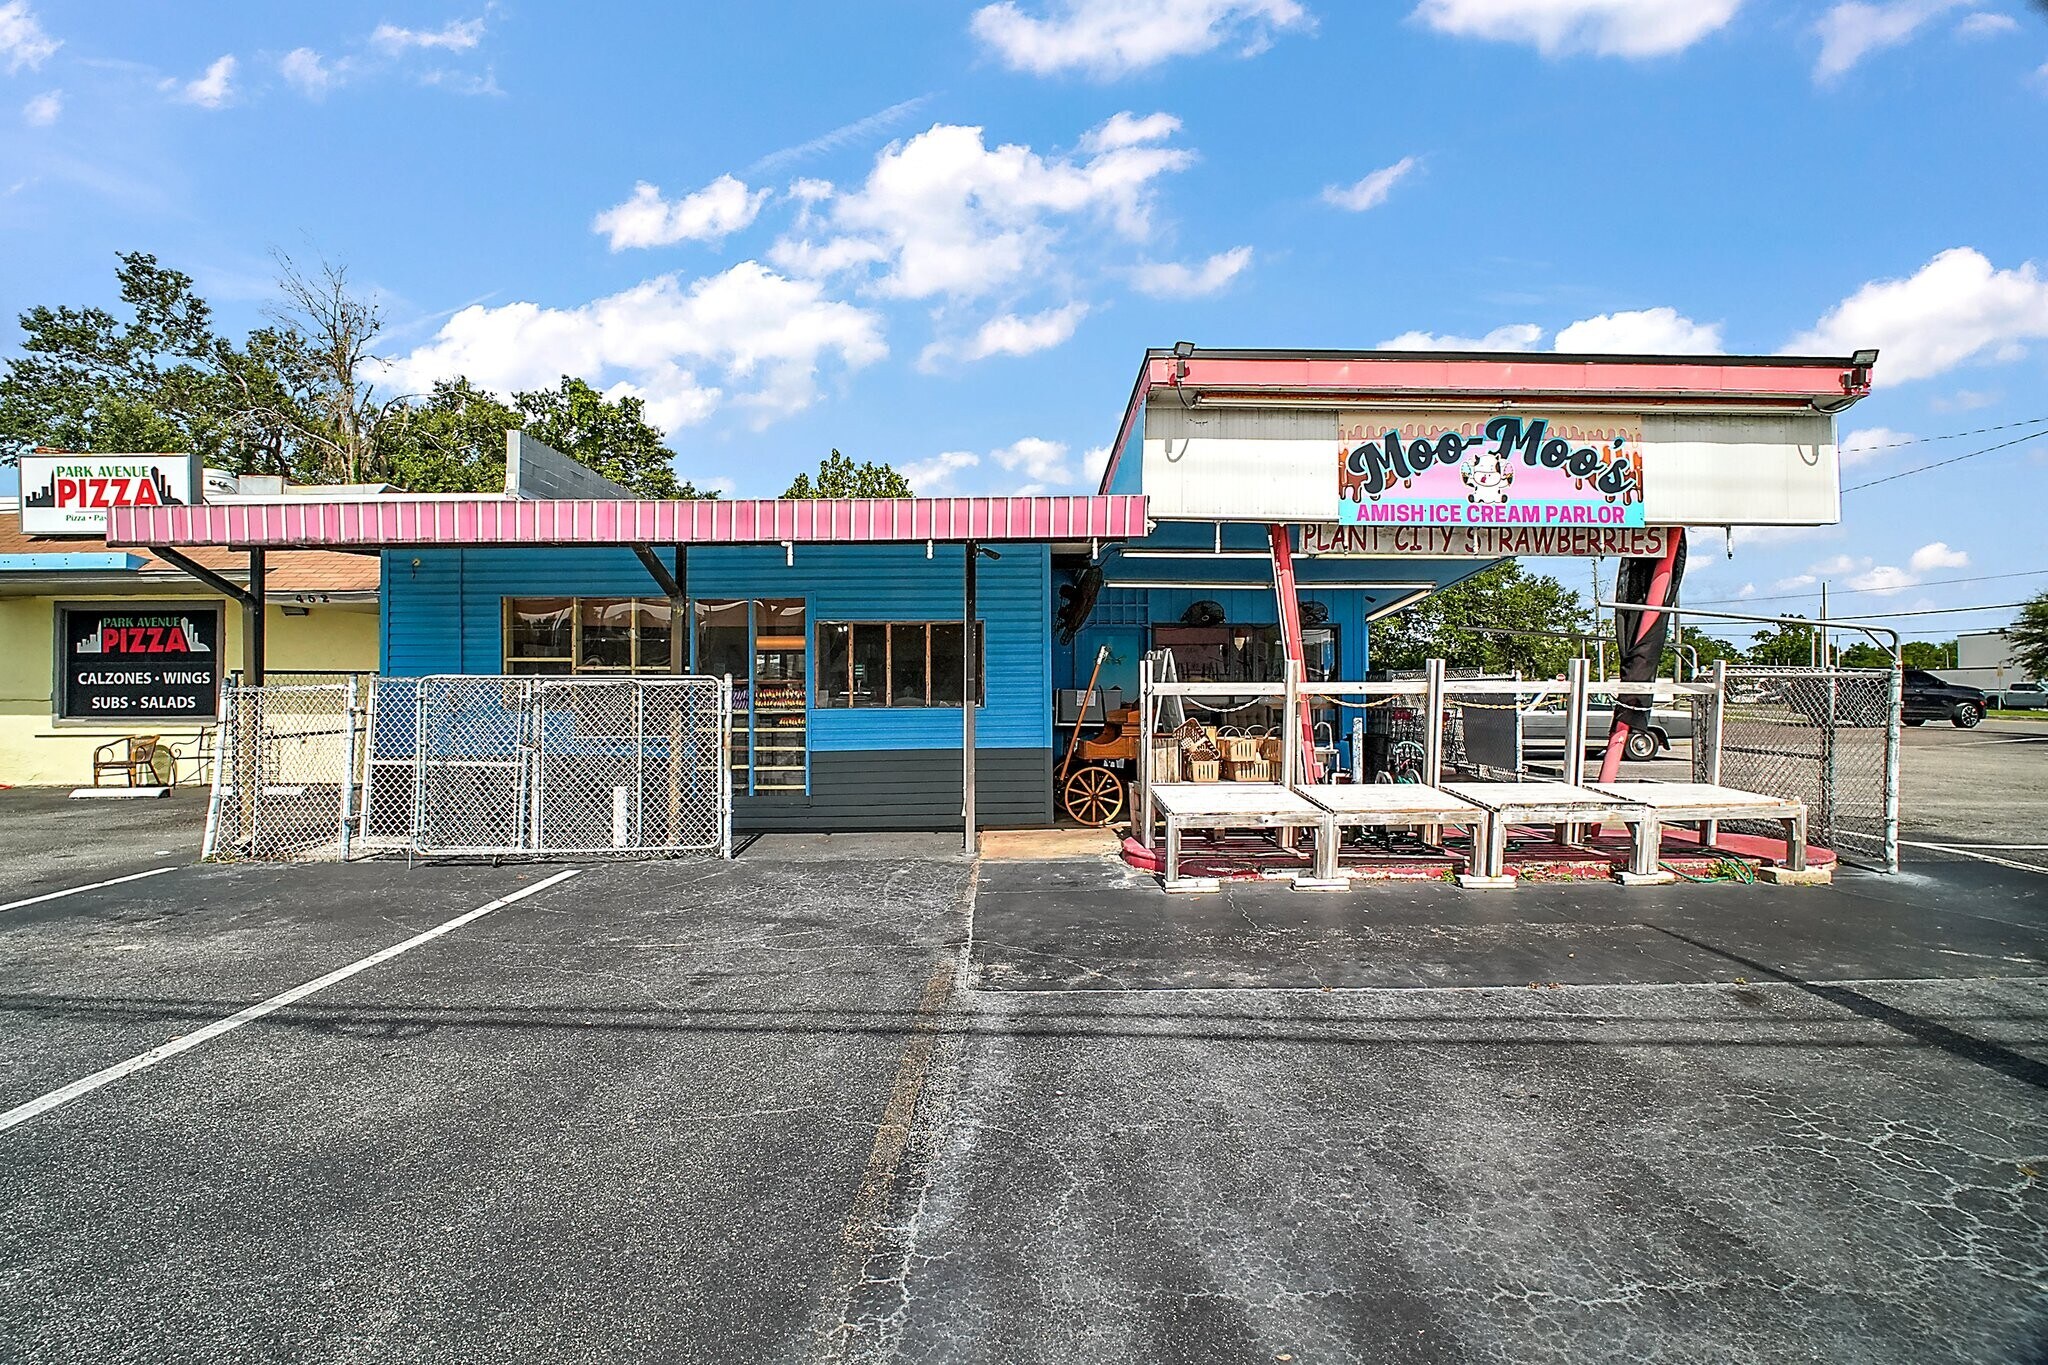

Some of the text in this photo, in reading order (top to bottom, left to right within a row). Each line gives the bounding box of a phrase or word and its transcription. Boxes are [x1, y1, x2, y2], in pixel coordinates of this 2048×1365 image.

[1346, 416, 1636, 495] Moo-Moo's
[56, 465, 150, 478] PARK AVENUE
[57, 478, 159, 508] PIZZA
[1356, 503, 1625, 524] AMISH ICE CREAM PARLOR
[1303, 523, 1662, 555] PLANT CITY STRAWBERRIES
[295, 594, 330, 604] 452
[102, 616, 180, 628] PARK AVENUE
[102, 627, 188, 654] PIZZA
[77, 671, 211, 685] CALZONES WINGS
[91, 696, 196, 709] SUBS SALADS
